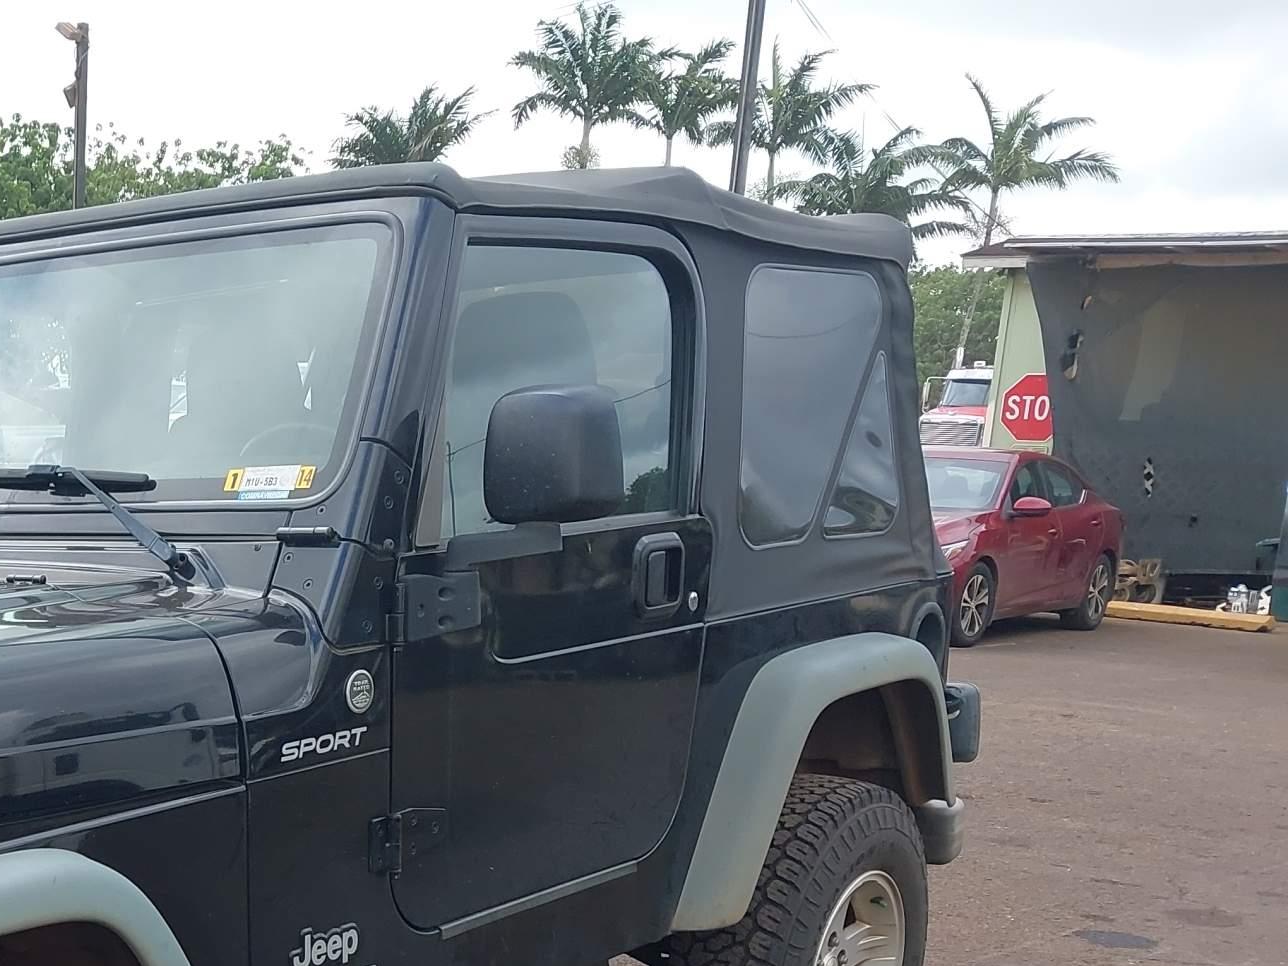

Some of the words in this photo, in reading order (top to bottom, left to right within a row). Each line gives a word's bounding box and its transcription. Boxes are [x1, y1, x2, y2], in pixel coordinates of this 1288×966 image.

[1005, 394, 1051, 421] STO
[297, 468, 314, 487] 14
[280, 725, 368, 763] SPORT
